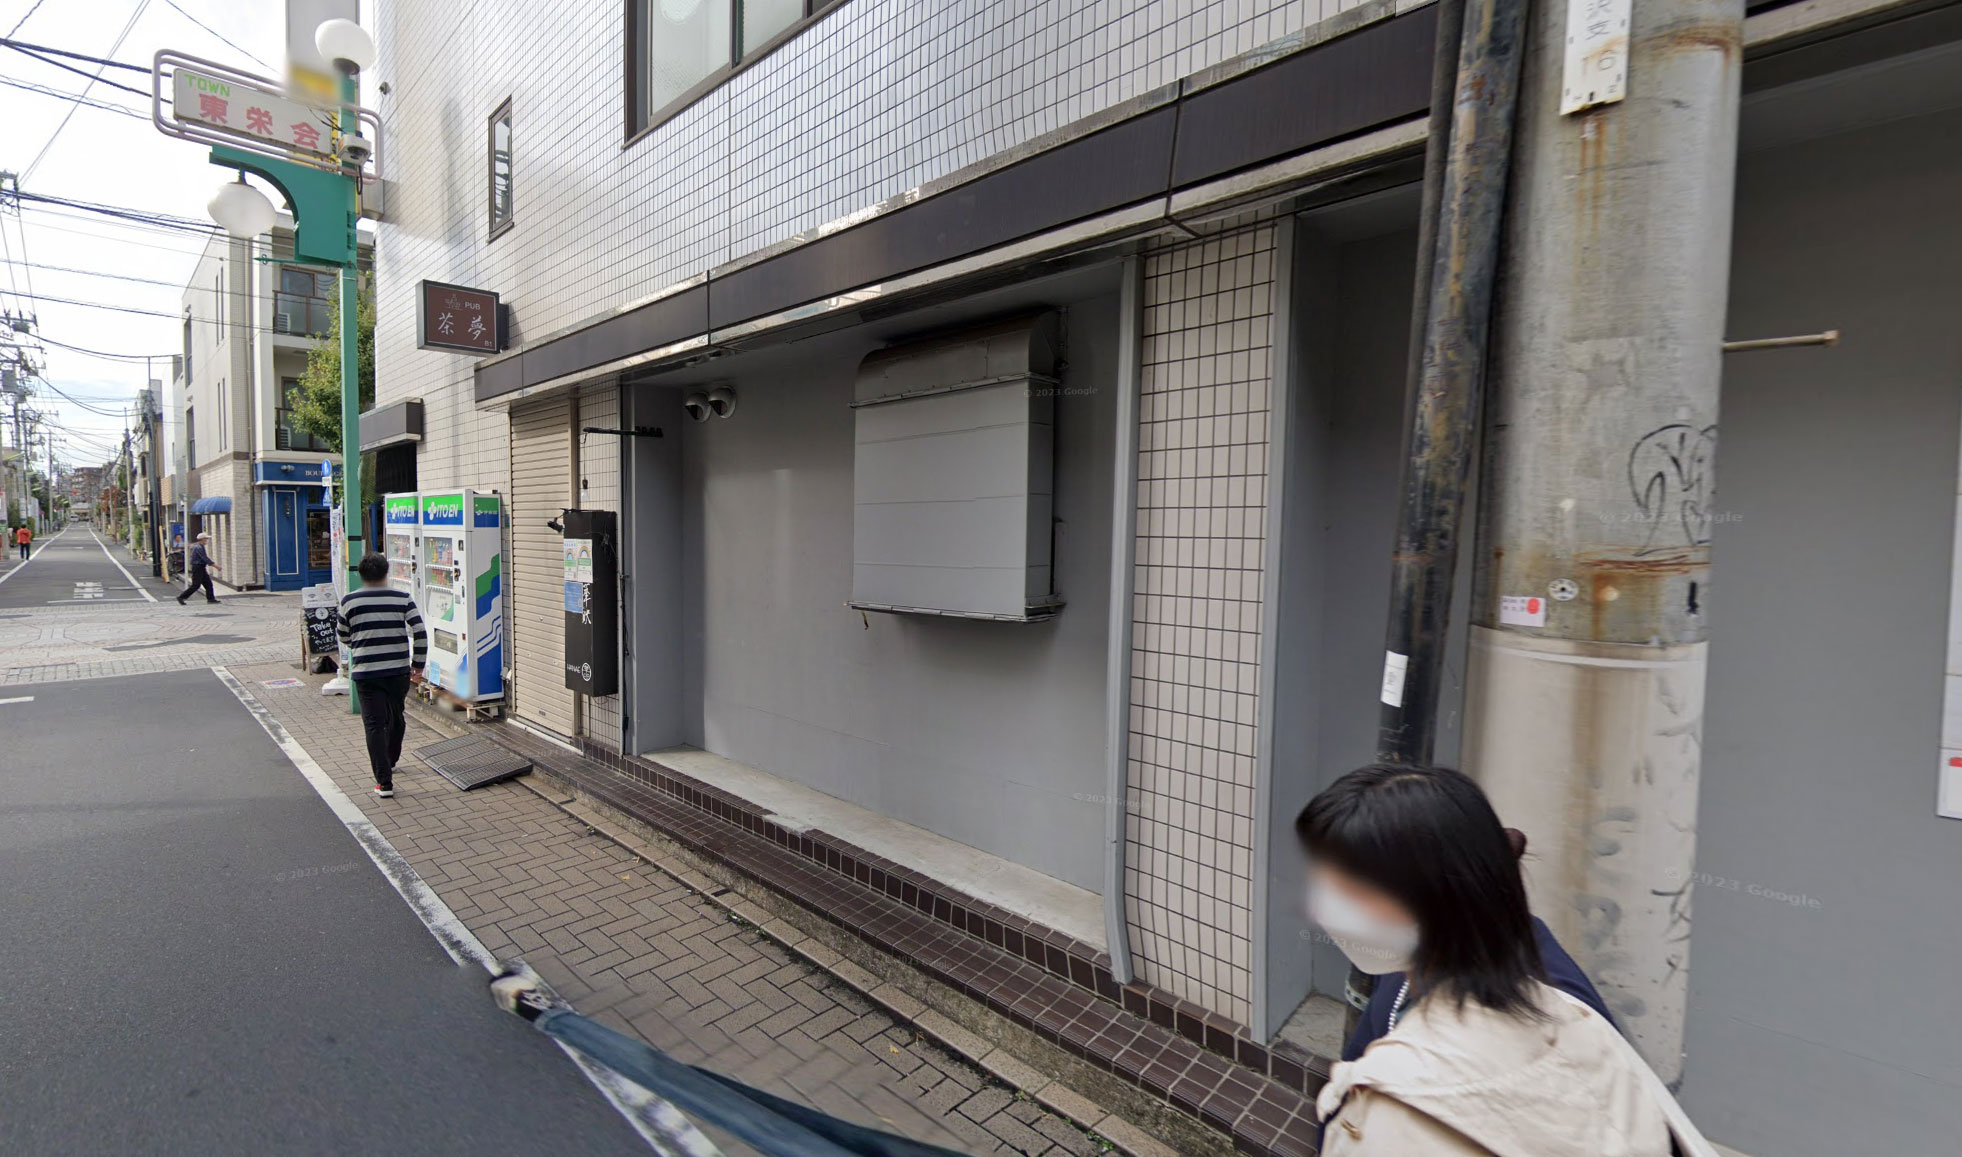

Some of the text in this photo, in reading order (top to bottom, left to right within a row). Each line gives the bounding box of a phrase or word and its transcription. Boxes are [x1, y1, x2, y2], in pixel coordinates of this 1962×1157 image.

[184, 74, 231, 97] TOWN
[198, 93, 321, 149] 東栄会
[465, 301, 481, 310] PUB
[438, 312, 487, 341] 茶夢
[309, 621, 331, 632] Take
